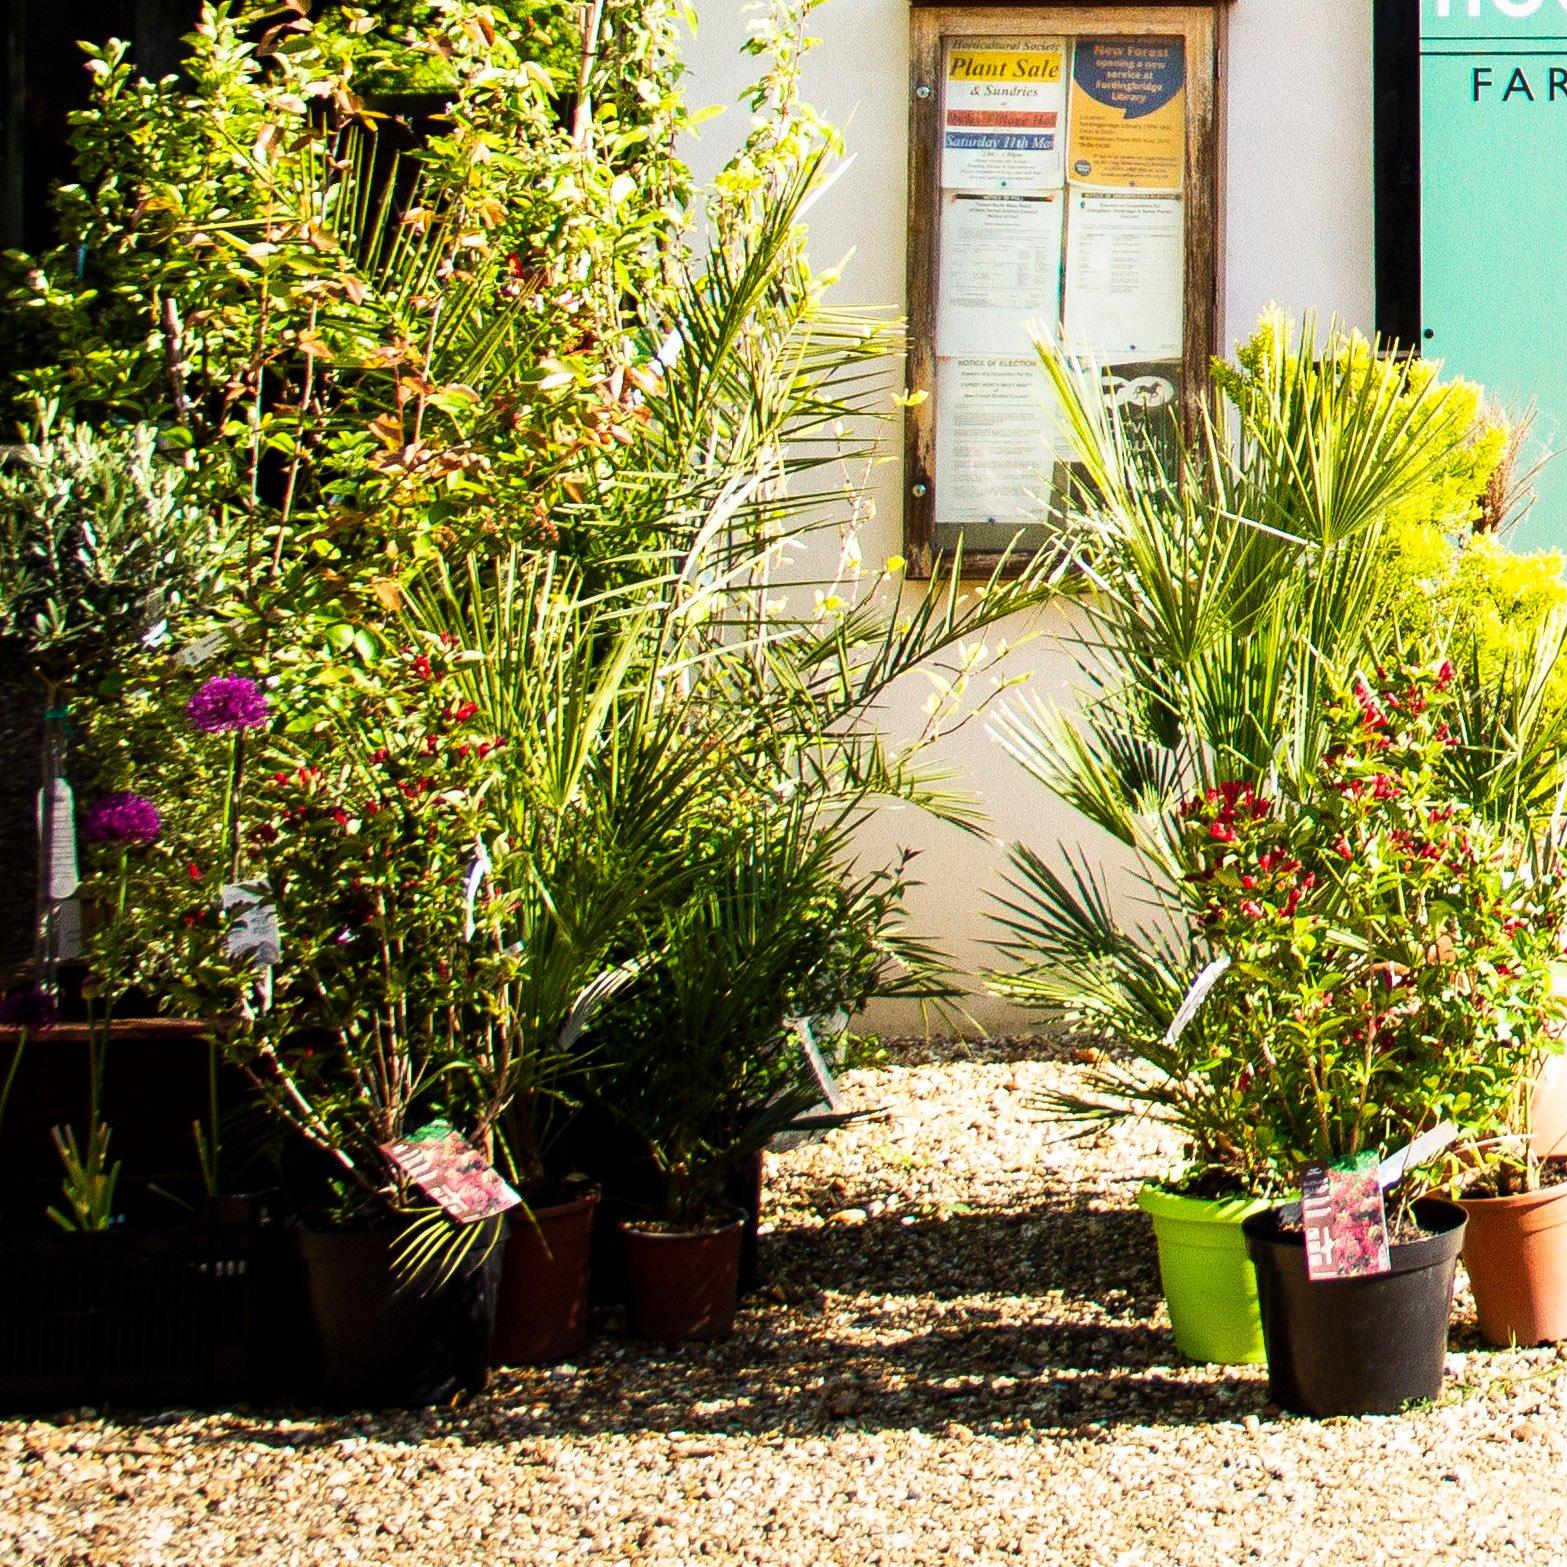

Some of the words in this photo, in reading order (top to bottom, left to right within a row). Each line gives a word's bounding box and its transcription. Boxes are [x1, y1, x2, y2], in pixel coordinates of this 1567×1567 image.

[949, 57, 1007, 78] Plant
[1012, 58, 1059, 78] Sale
[983, 84, 1039, 97] Sundries
[947, 134, 1000, 149] Saturday
